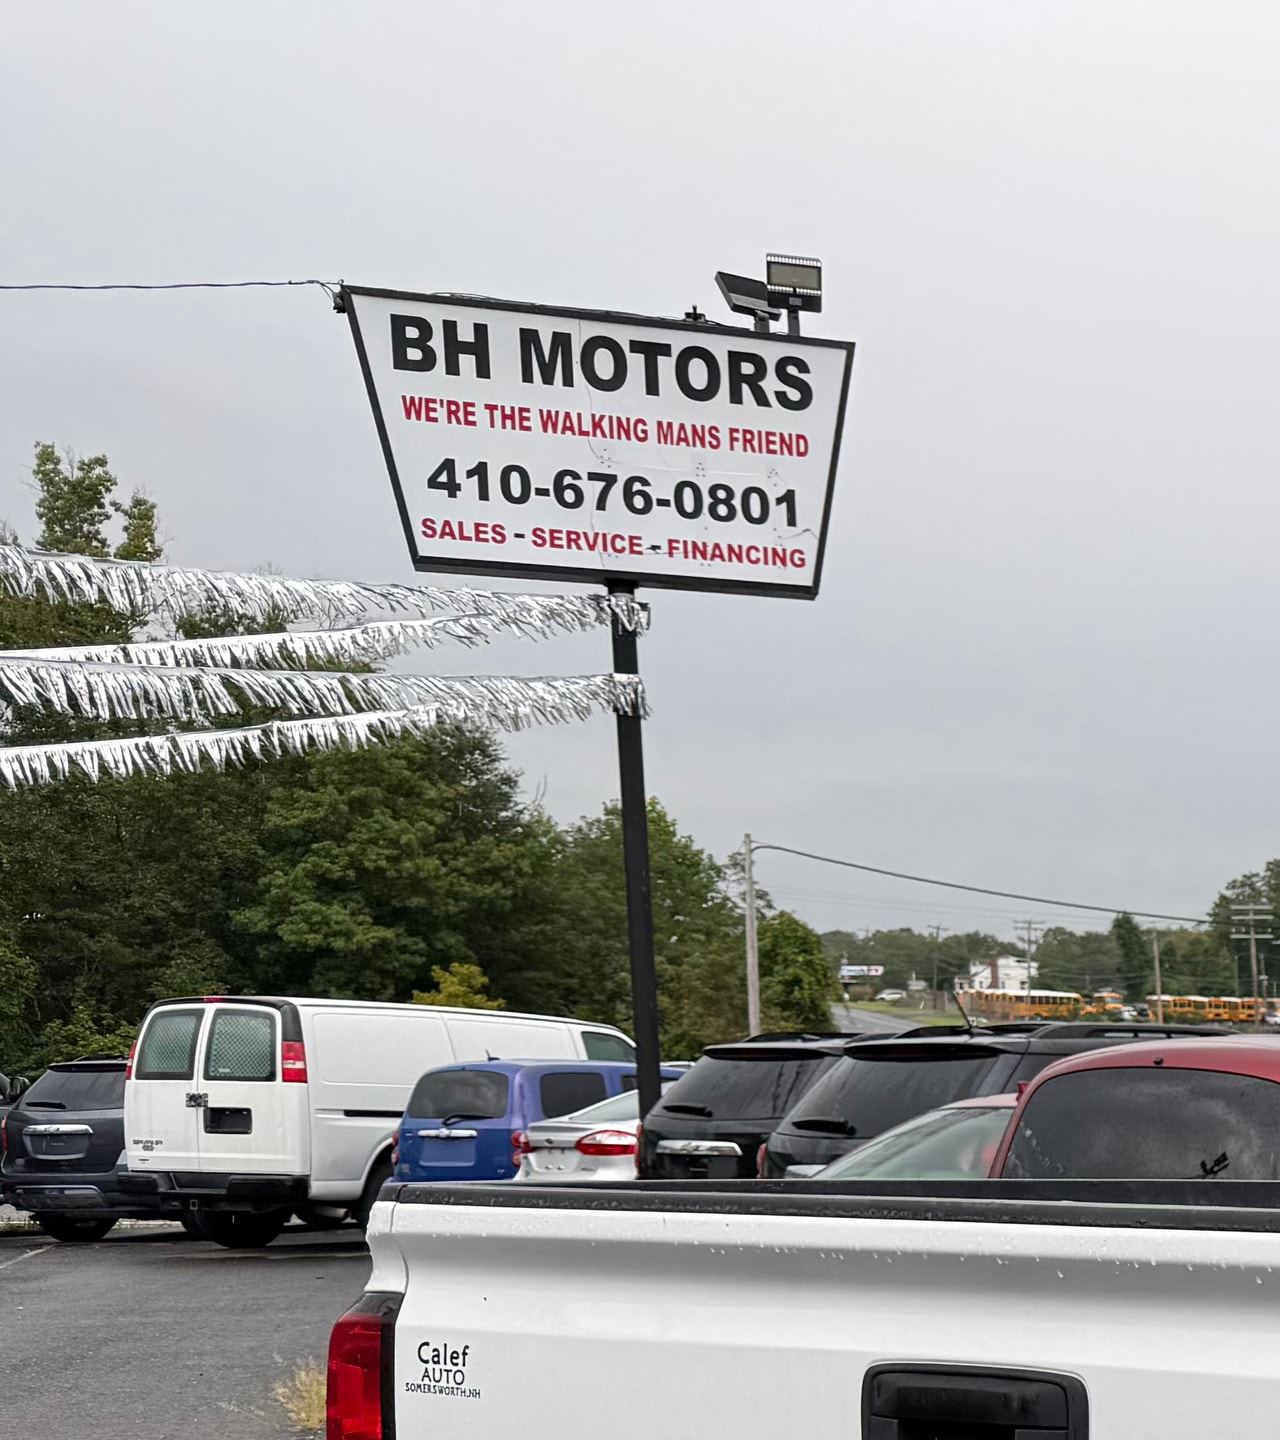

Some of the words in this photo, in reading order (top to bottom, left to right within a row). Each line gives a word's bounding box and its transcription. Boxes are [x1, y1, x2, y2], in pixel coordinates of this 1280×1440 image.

[390, 312, 492, 381] BH
[519, 327, 814, 412] MOTORS
[401, 395, 477, 427] WE'RE
[484, 403, 532, 431] THE
[538, 408, 649, 443] WALKING
[656, 420, 721, 450] MANS
[728, 427, 809, 457] FRIEND
[427, 457, 798, 528] 410-676-0801
[421, 517, 506, 545] SALES
[531, 527, 644, 555] SERVICE
[667, 538, 806, 569] FINANCING
[417, 1341, 469, 1367] Calef
[421, 1366, 465, 1386] AUTO
